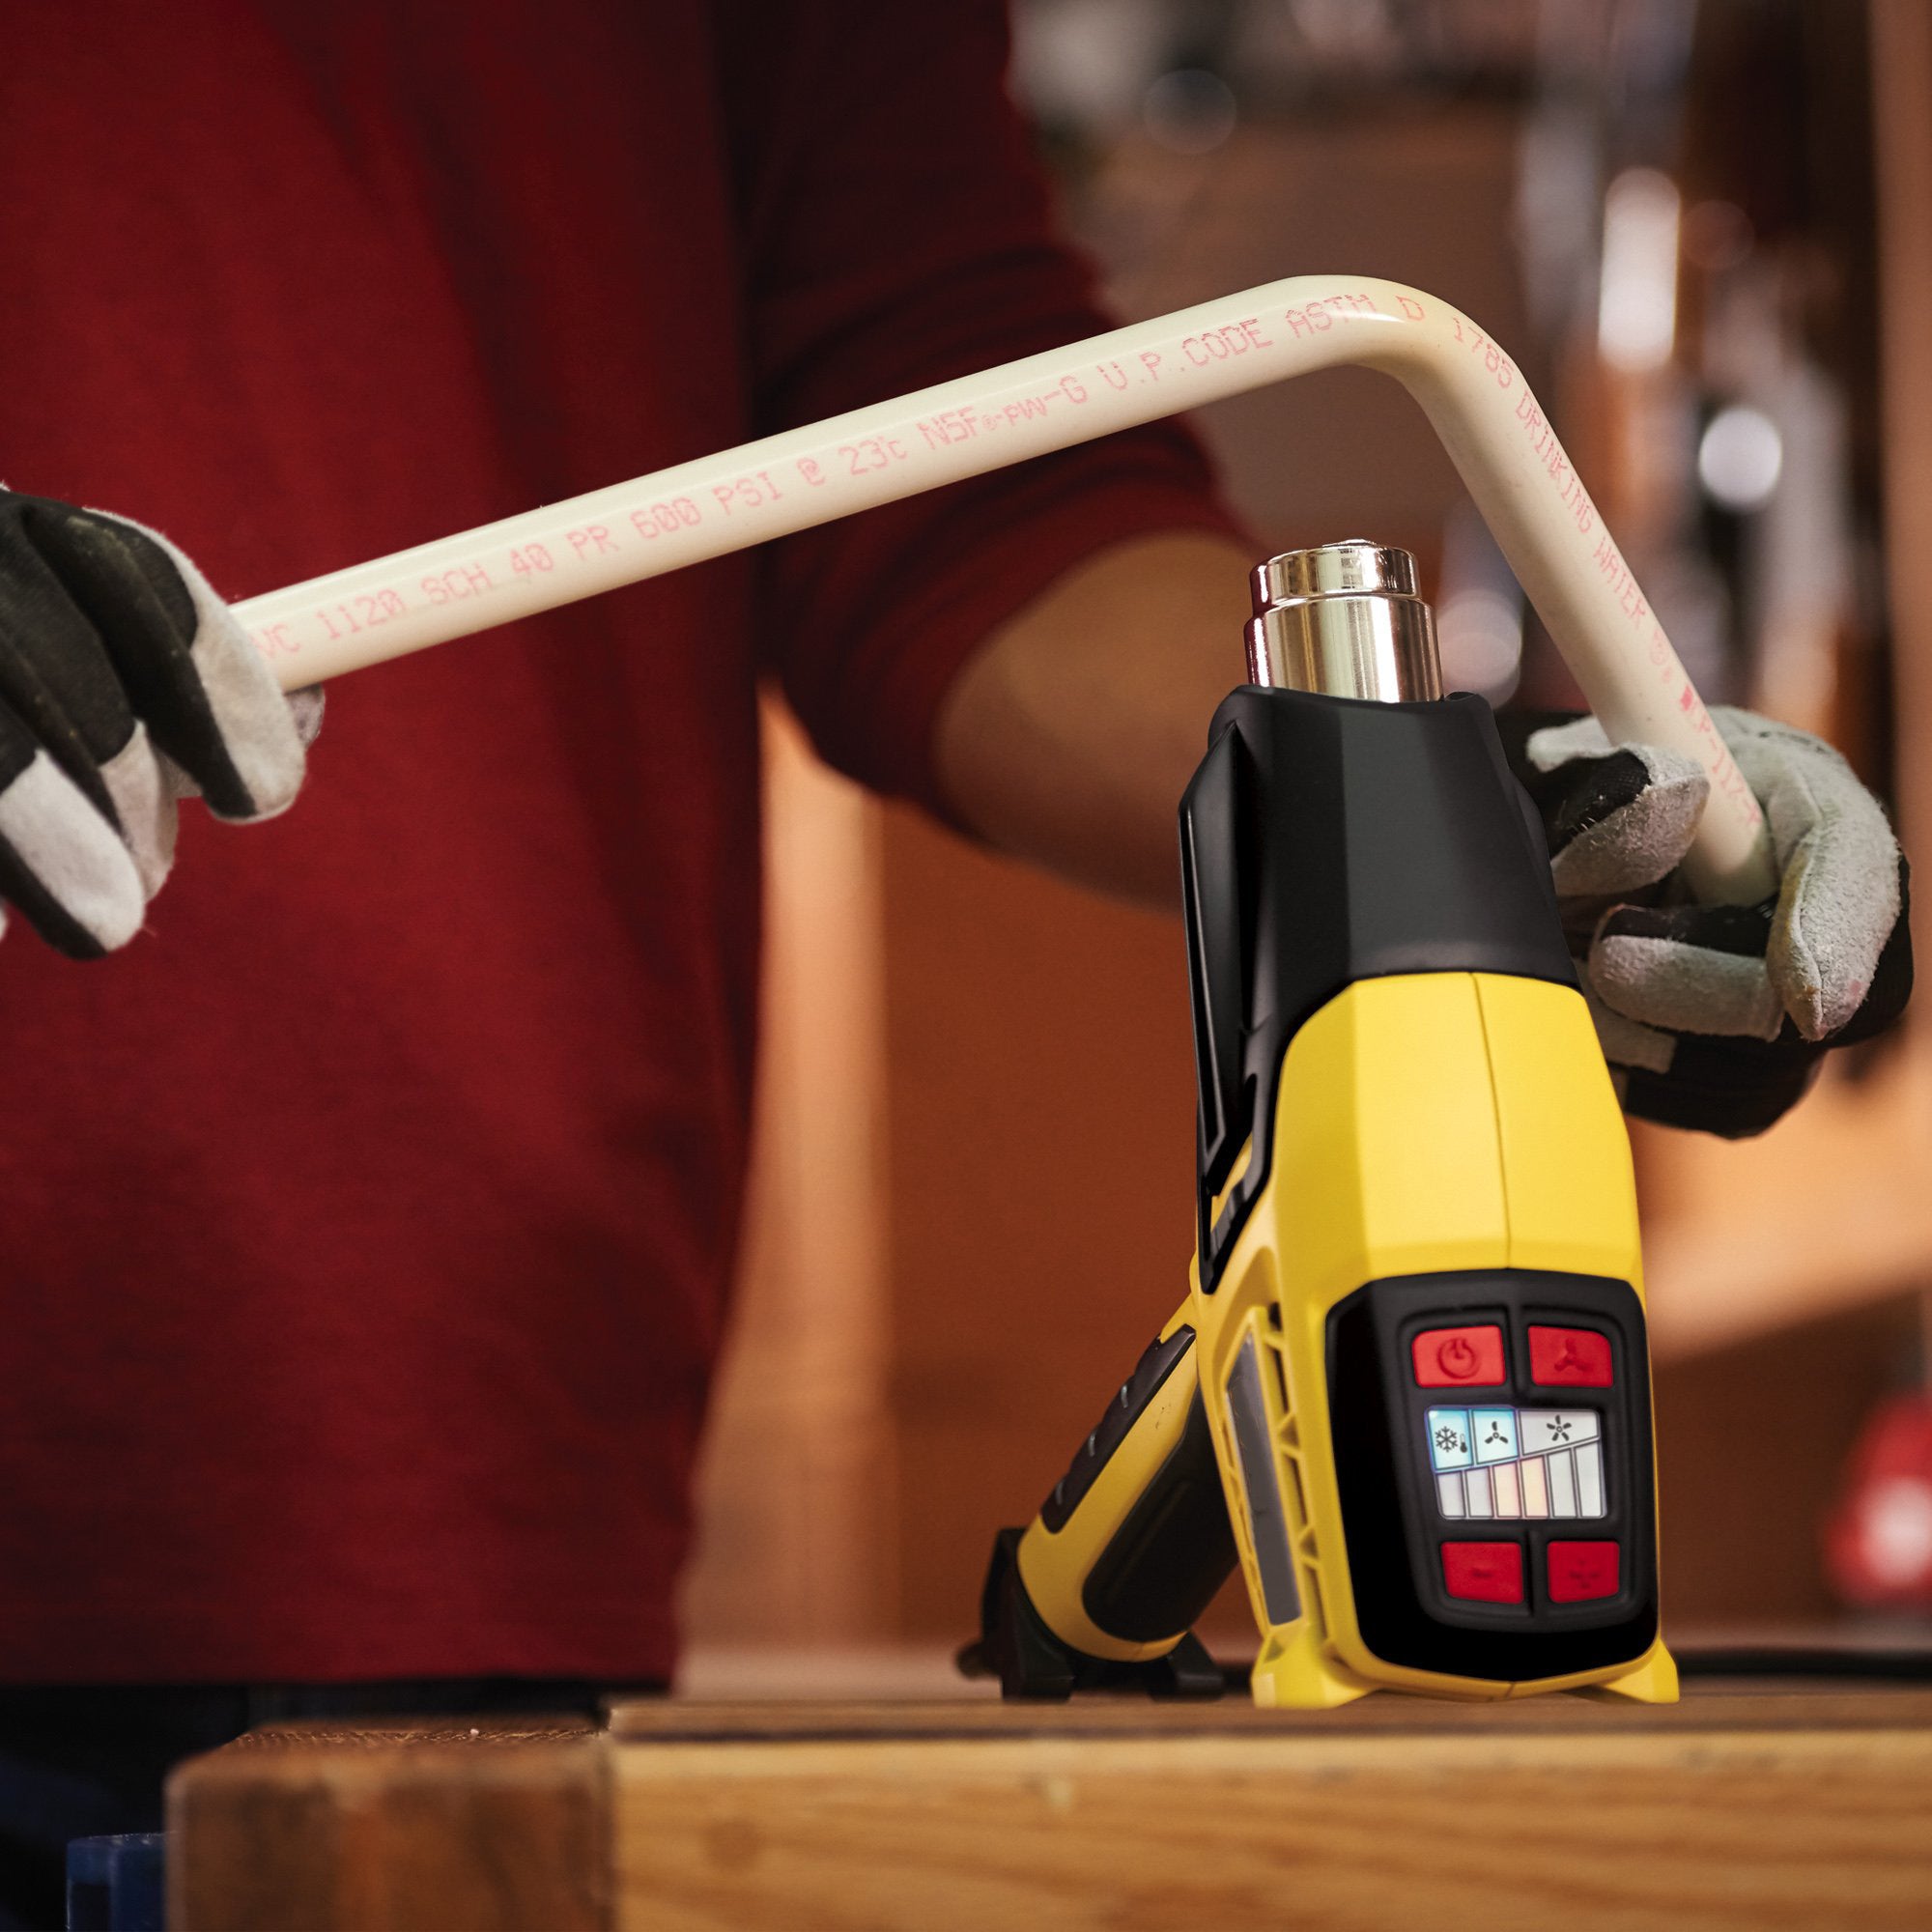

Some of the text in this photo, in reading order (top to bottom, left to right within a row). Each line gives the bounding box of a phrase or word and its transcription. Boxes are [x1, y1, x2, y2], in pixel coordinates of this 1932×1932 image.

[251, 623, 300, 659] VC
[316, 587, 407, 639] 1120
[420, 562, 494, 606] SCH
[508, 543, 554, 577] 40
[566, 526, 619, 560] PR
[629, 497, 702, 539] 600
[711, 471, 784, 516] PSI
[795, 457, 827, 487] @
[1395, 294, 1426, 323] D
[1452, 316, 1515, 389] 1785
[1515, 389, 1595, 534] DRINKING
[1593, 535, 1647, 631] WATER
